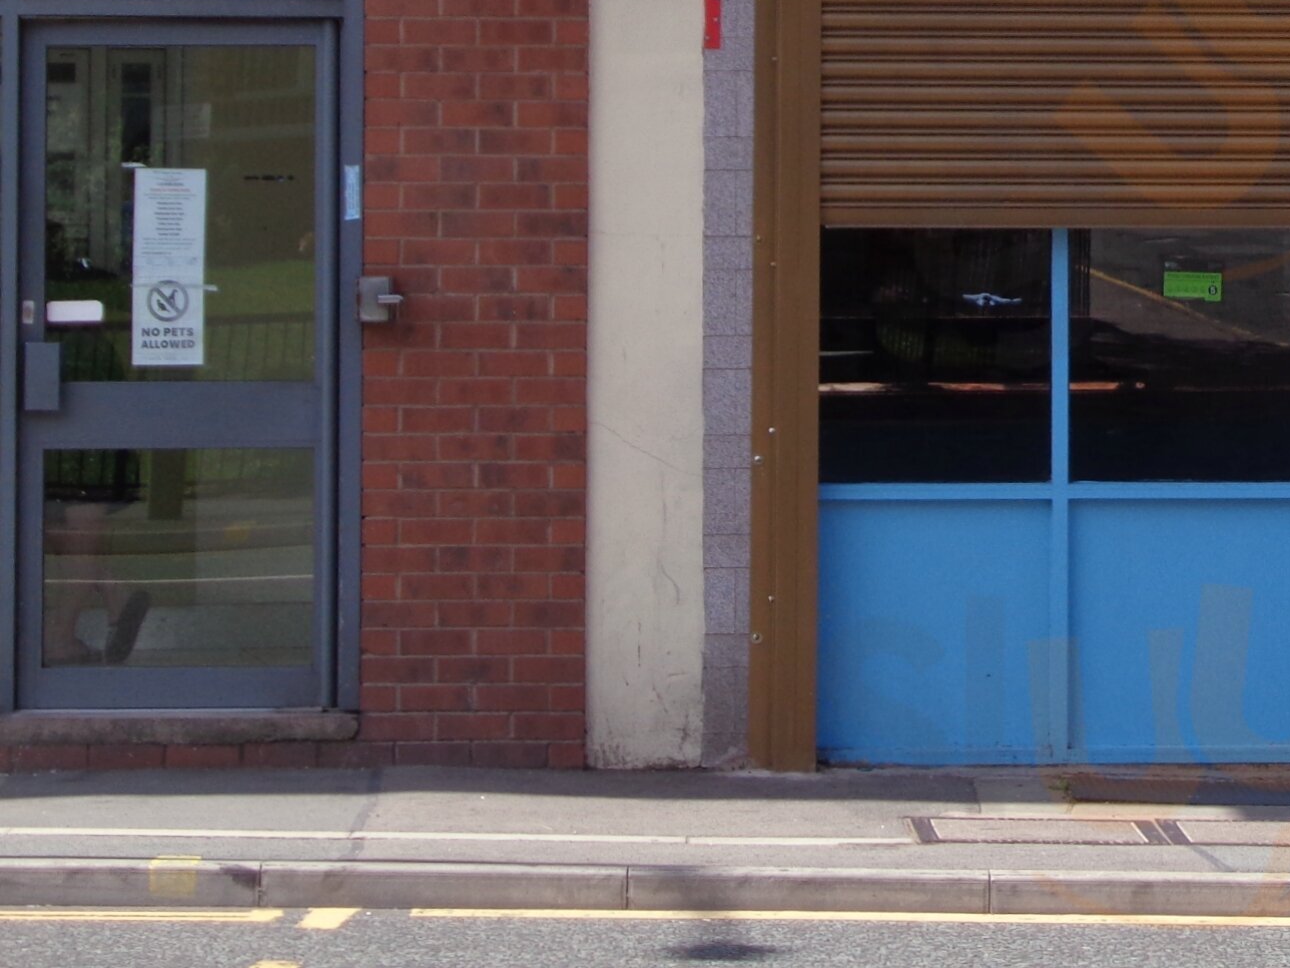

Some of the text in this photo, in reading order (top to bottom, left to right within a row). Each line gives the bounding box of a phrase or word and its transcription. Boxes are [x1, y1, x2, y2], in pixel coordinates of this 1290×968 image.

[141, 327, 194, 337] NO PETS
[141, 339, 195, 349] ALLOWED
